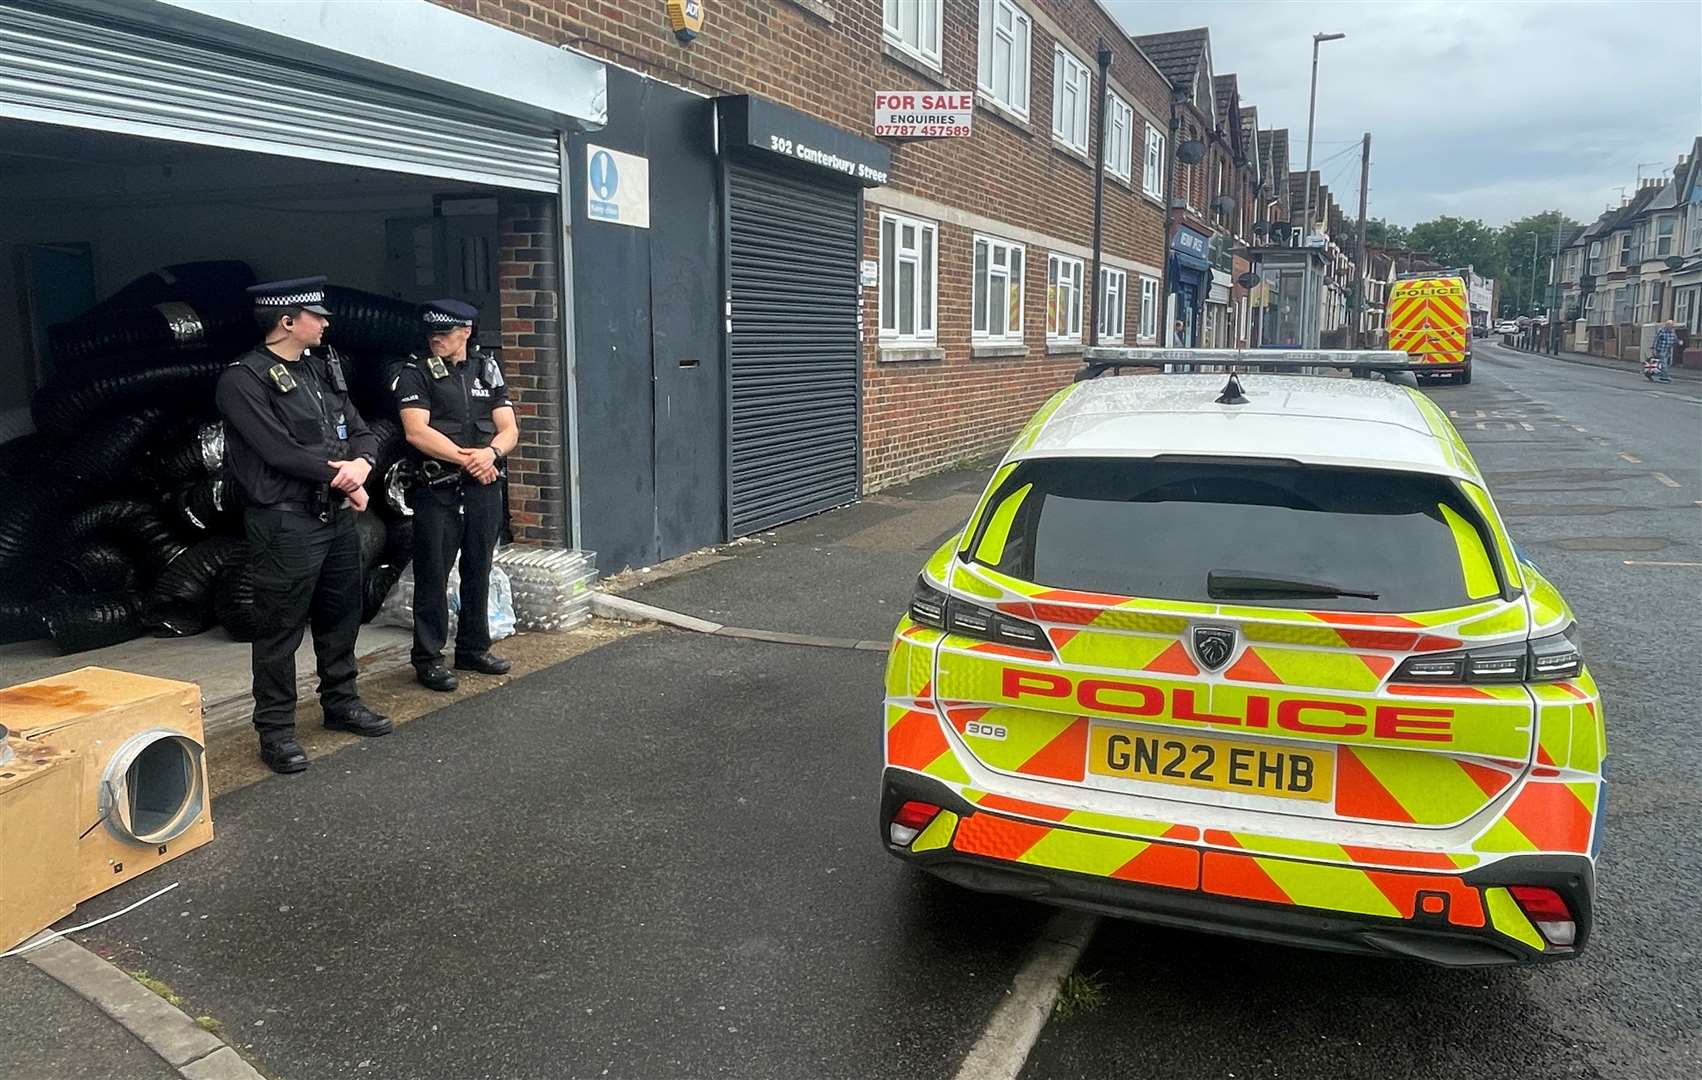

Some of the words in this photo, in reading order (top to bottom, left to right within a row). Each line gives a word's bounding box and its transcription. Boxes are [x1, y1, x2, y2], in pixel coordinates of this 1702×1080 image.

[876, 95, 915, 110] FOR
[921, 95, 971, 110] SALE
[890, 114, 956, 124] ENQUIRIES
[876, 125, 916, 135] 07787
[920, 126, 970, 136] 457589
[770, 135, 793, 154] 302
[796, 143, 856, 176] Canterbury
[858, 163, 888, 184] Street
[1395, 287, 1461, 297] POLICE
[1002, 668, 1454, 742] POLICE
[967, 723, 1006, 738] 308
[1107, 735, 1215, 782] GN22
[1229, 748, 1314, 793] EHB
